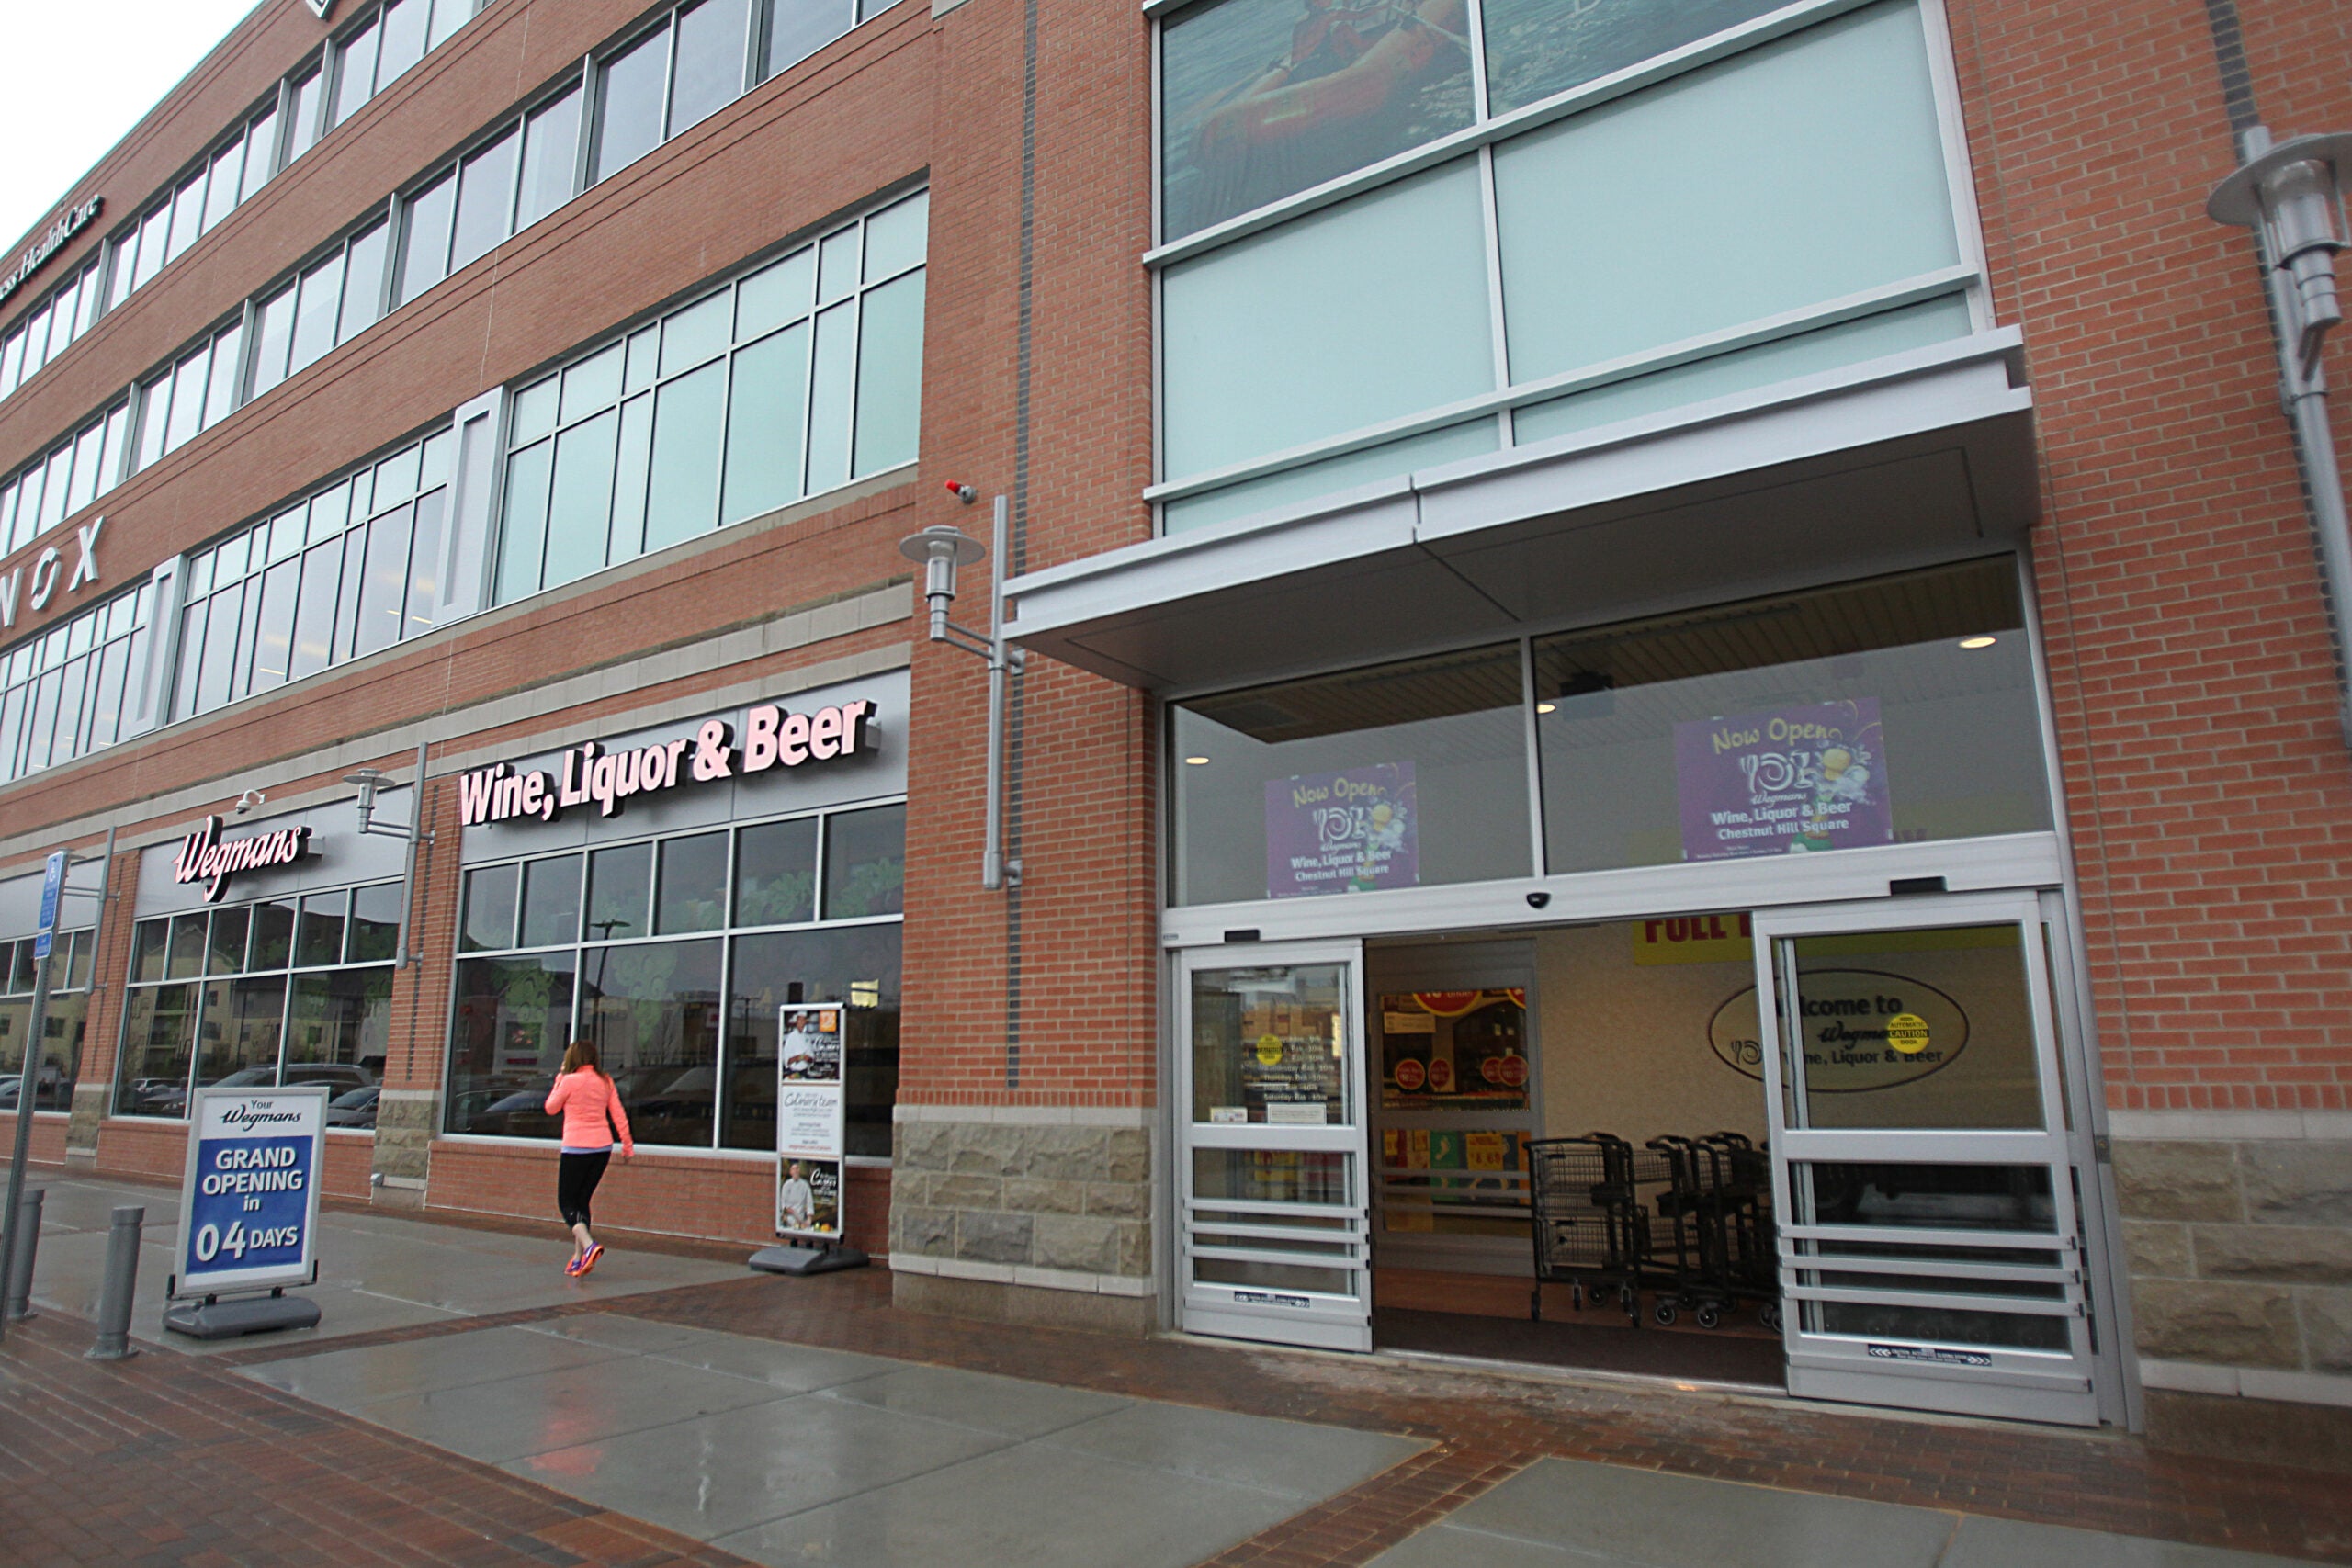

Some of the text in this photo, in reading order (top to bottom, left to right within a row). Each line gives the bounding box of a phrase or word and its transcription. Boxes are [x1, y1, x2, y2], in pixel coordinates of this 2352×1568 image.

[18, 194, 101, 281] HealthCare
[1712, 717, 1842, 754] Now Open
[459, 699, 871, 826] Wine, Liquor & Beer
[1292, 777, 1385, 808] Now Open
[1750, 791, 1807, 808] Wegmans
[1712, 801, 1852, 825] Wine, Liquor & Beer
[1718, 818, 1849, 840] Chestnut Hill Square
[172, 815, 308, 903] Wegmans
[1291, 855, 1321, 869] Wine,
[1323, 853, 1353, 868] Liquor
[1368, 850, 1392, 862] Beer
[1295, 864, 1389, 882] Chestnut Hill Square
[1775, 995, 1904, 1017] lcome to
[1817, 1021, 1889, 1050] Wegma
[1889, 1030, 1928, 1038] CAUTION
[1832, 1050, 1880, 1066] Liquor
[1884, 1049, 1898, 1063] &
[251, 1099, 274, 1110] Your
[220, 1104, 301, 1132] Wegmans
[215, 1147, 297, 1170] GRAND
[202, 1169, 303, 1195] OPENING
[243, 1195, 261, 1212] in
[250, 1226, 299, 1249] DAYS
